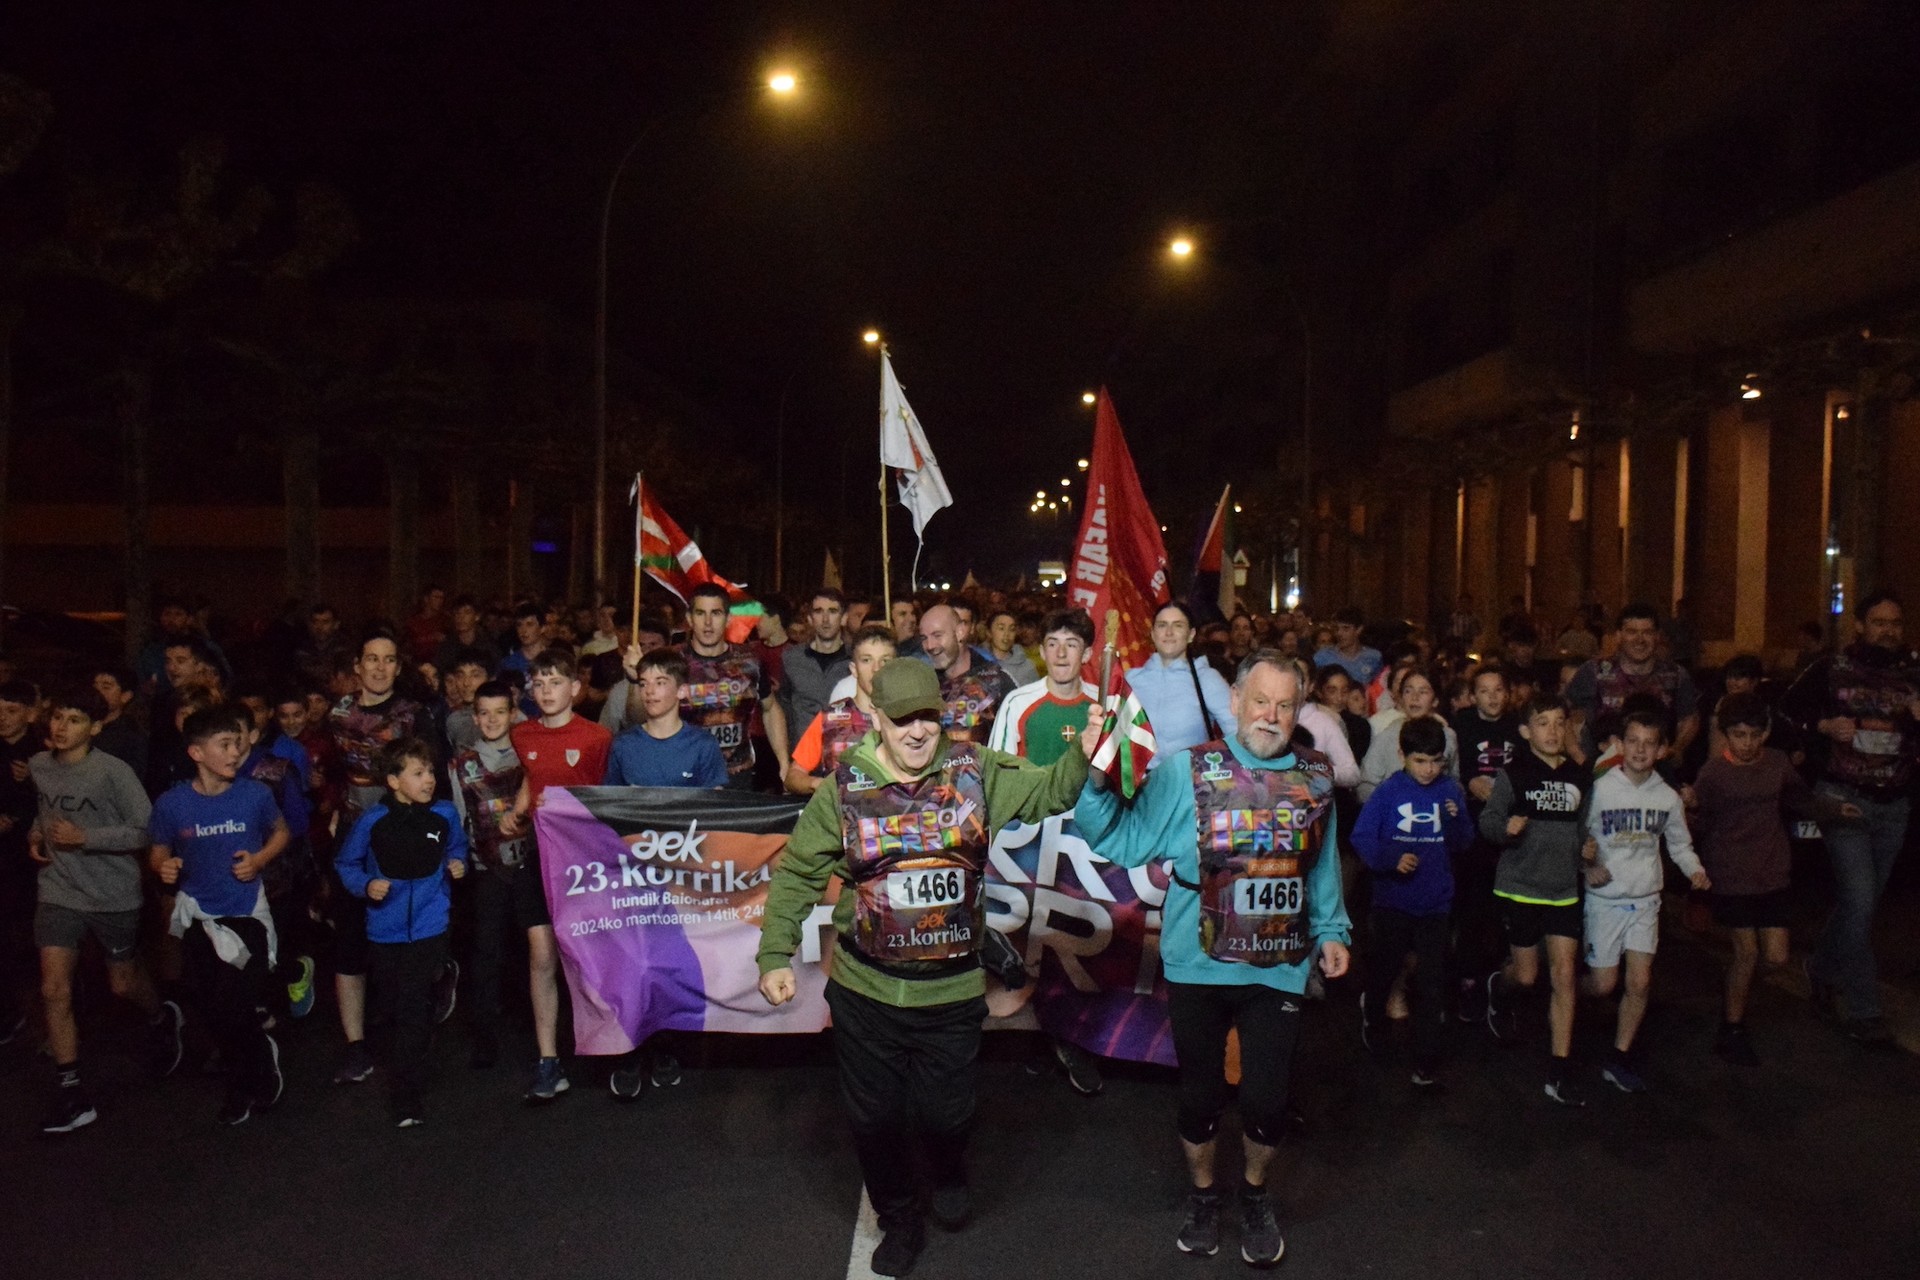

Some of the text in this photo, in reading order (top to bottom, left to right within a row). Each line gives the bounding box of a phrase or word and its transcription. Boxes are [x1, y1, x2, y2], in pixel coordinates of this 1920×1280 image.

[1525, 790, 1565, 801] NORTH
[1541, 780, 1565, 791] THE
[1536, 800, 1565, 811] FACE
[195, 818, 246, 838] korrika
[1601, 808, 1641, 836] SPORTS
[631, 818, 708, 864] aek
[565, 853, 772, 897] 23.korrika
[903, 870, 959, 905] 1466
[1246, 880, 1298, 910] 1466
[612, 892, 660, 910] Irundik
[571, 915, 623, 936] 2024ko
[626, 908, 700, 928] martxoaren
[706, 901, 740, 922] 14tik
[916, 909, 948, 930] aek
[887, 924, 972, 948] 23.korrika
